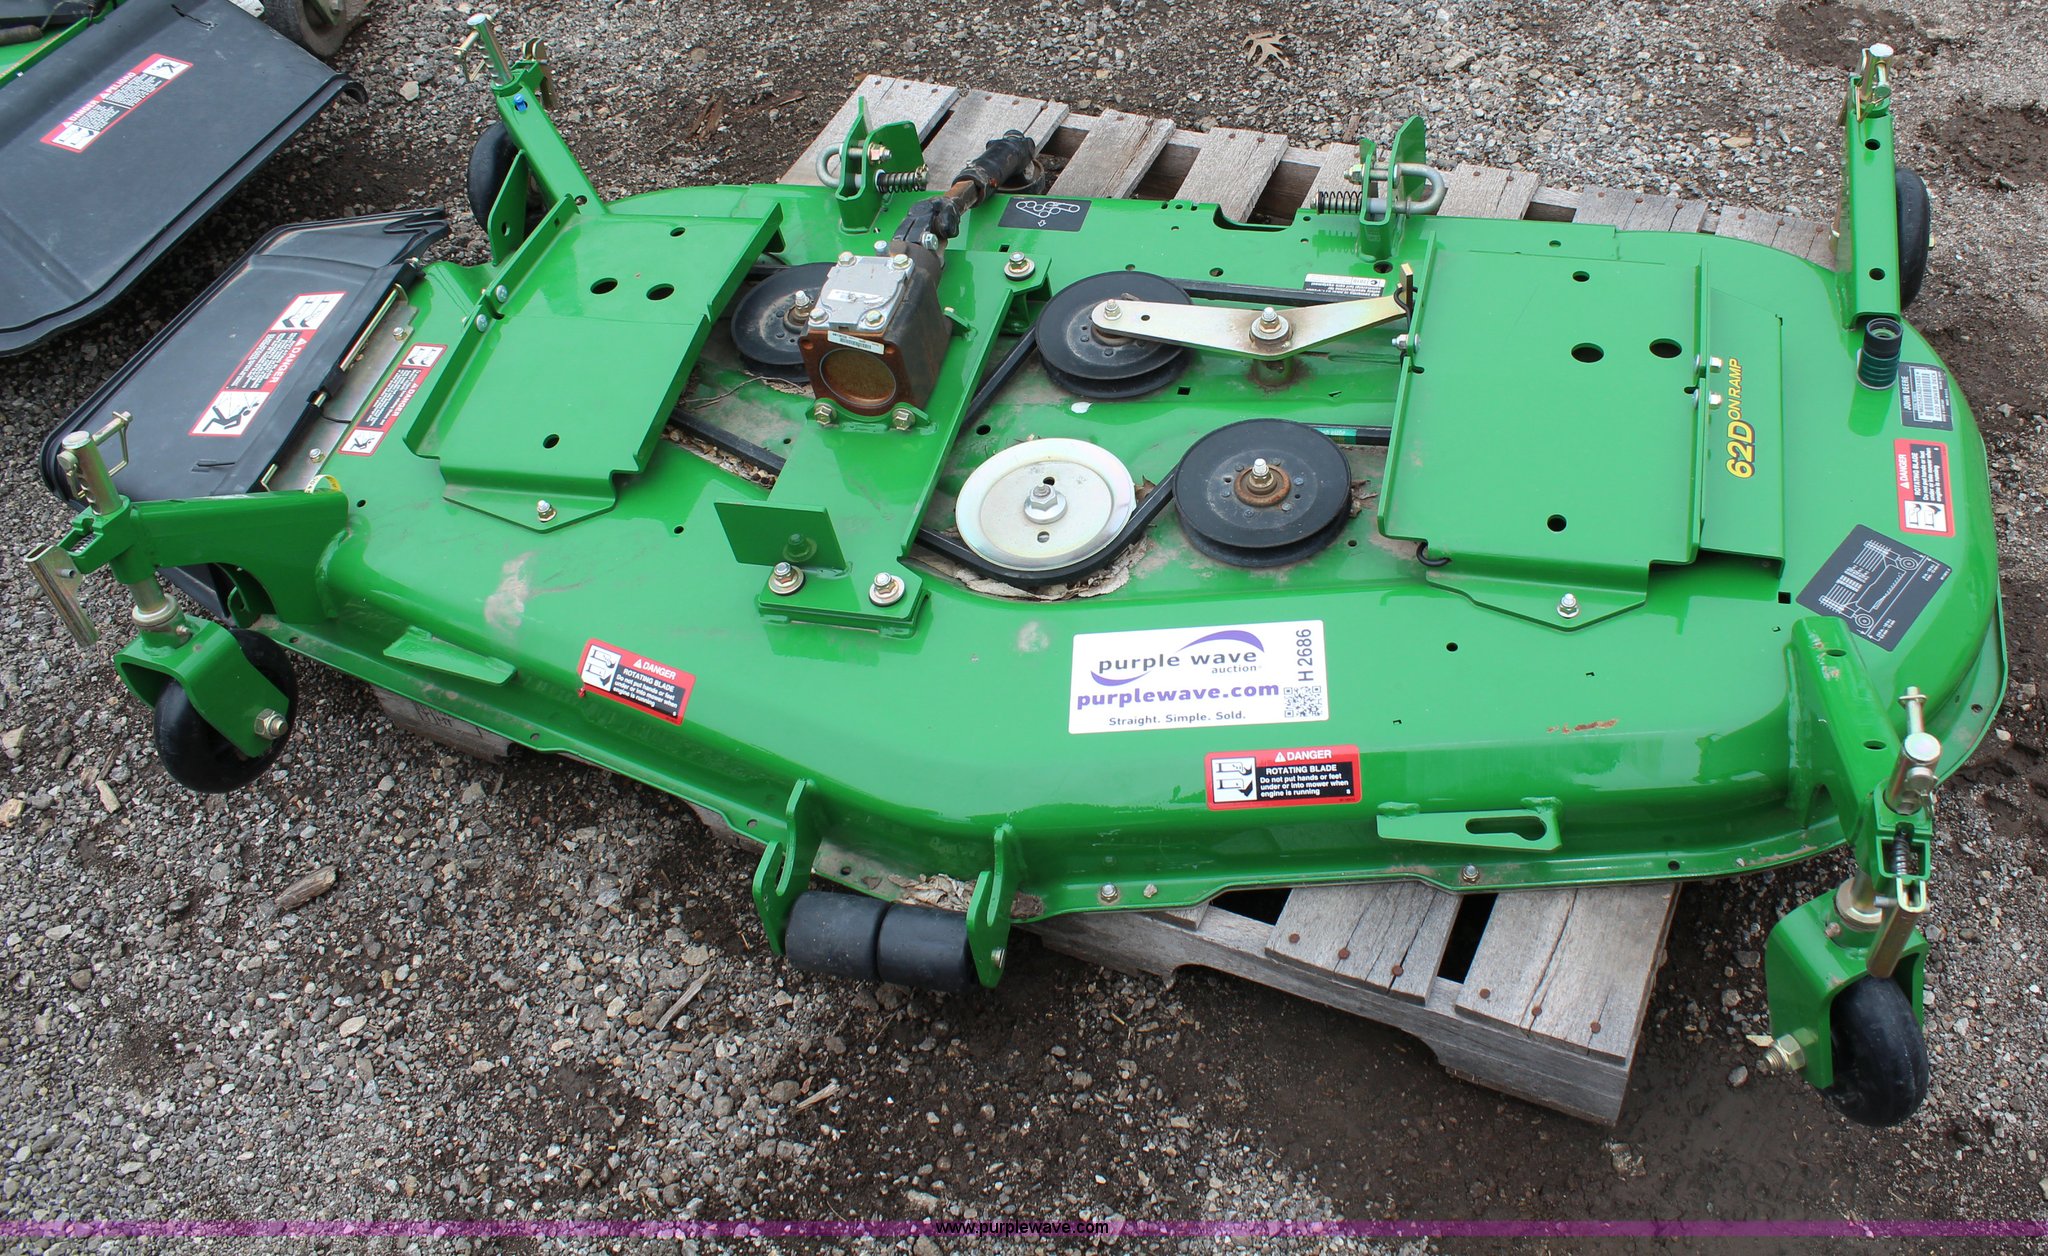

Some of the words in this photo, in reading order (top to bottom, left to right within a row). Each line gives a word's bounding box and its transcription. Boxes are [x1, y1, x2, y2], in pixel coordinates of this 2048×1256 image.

[270, 348, 302, 382] DANGER
[1901, 376, 1910, 393] DEERE
[392, 389, 416, 416] DANGER
[1903, 395, 1911, 410] JOHN
[1726, 420, 1755, 479] 62D
[1898, 454, 1908, 481] DANGER
[1912, 470, 1921, 495] ROTATING
[1296, 629, 1312, 666] 2686
[643, 661, 676, 680] DANGER
[1099, 654, 1180, 674] purple
[1190, 651, 1257, 666] wave
[1211, 665, 1257, 674] auction
[623, 668, 653, 684] ROTATING
[654, 680, 675, 692] BLADE
[1298, 670, 1314, 681] H
[615, 681, 629, 689] under
[646, 693, 663, 702] mower
[664, 700, 678, 708] when
[642, 684, 658, 694] hands
[1077, 684, 1279, 710] purplewave.com
[636, 695, 655, 707] running
[1109, 716, 1160, 726] Straight.
[1165, 713, 1211, 724] Simple.
[1216, 711, 1246, 720] Sold.
[1287, 750, 1332, 761] DANGER
[1266, 766, 1307, 775] ROTATING
[1310, 764, 1337, 773] BLADE
[1260, 790, 1284, 799] engine
